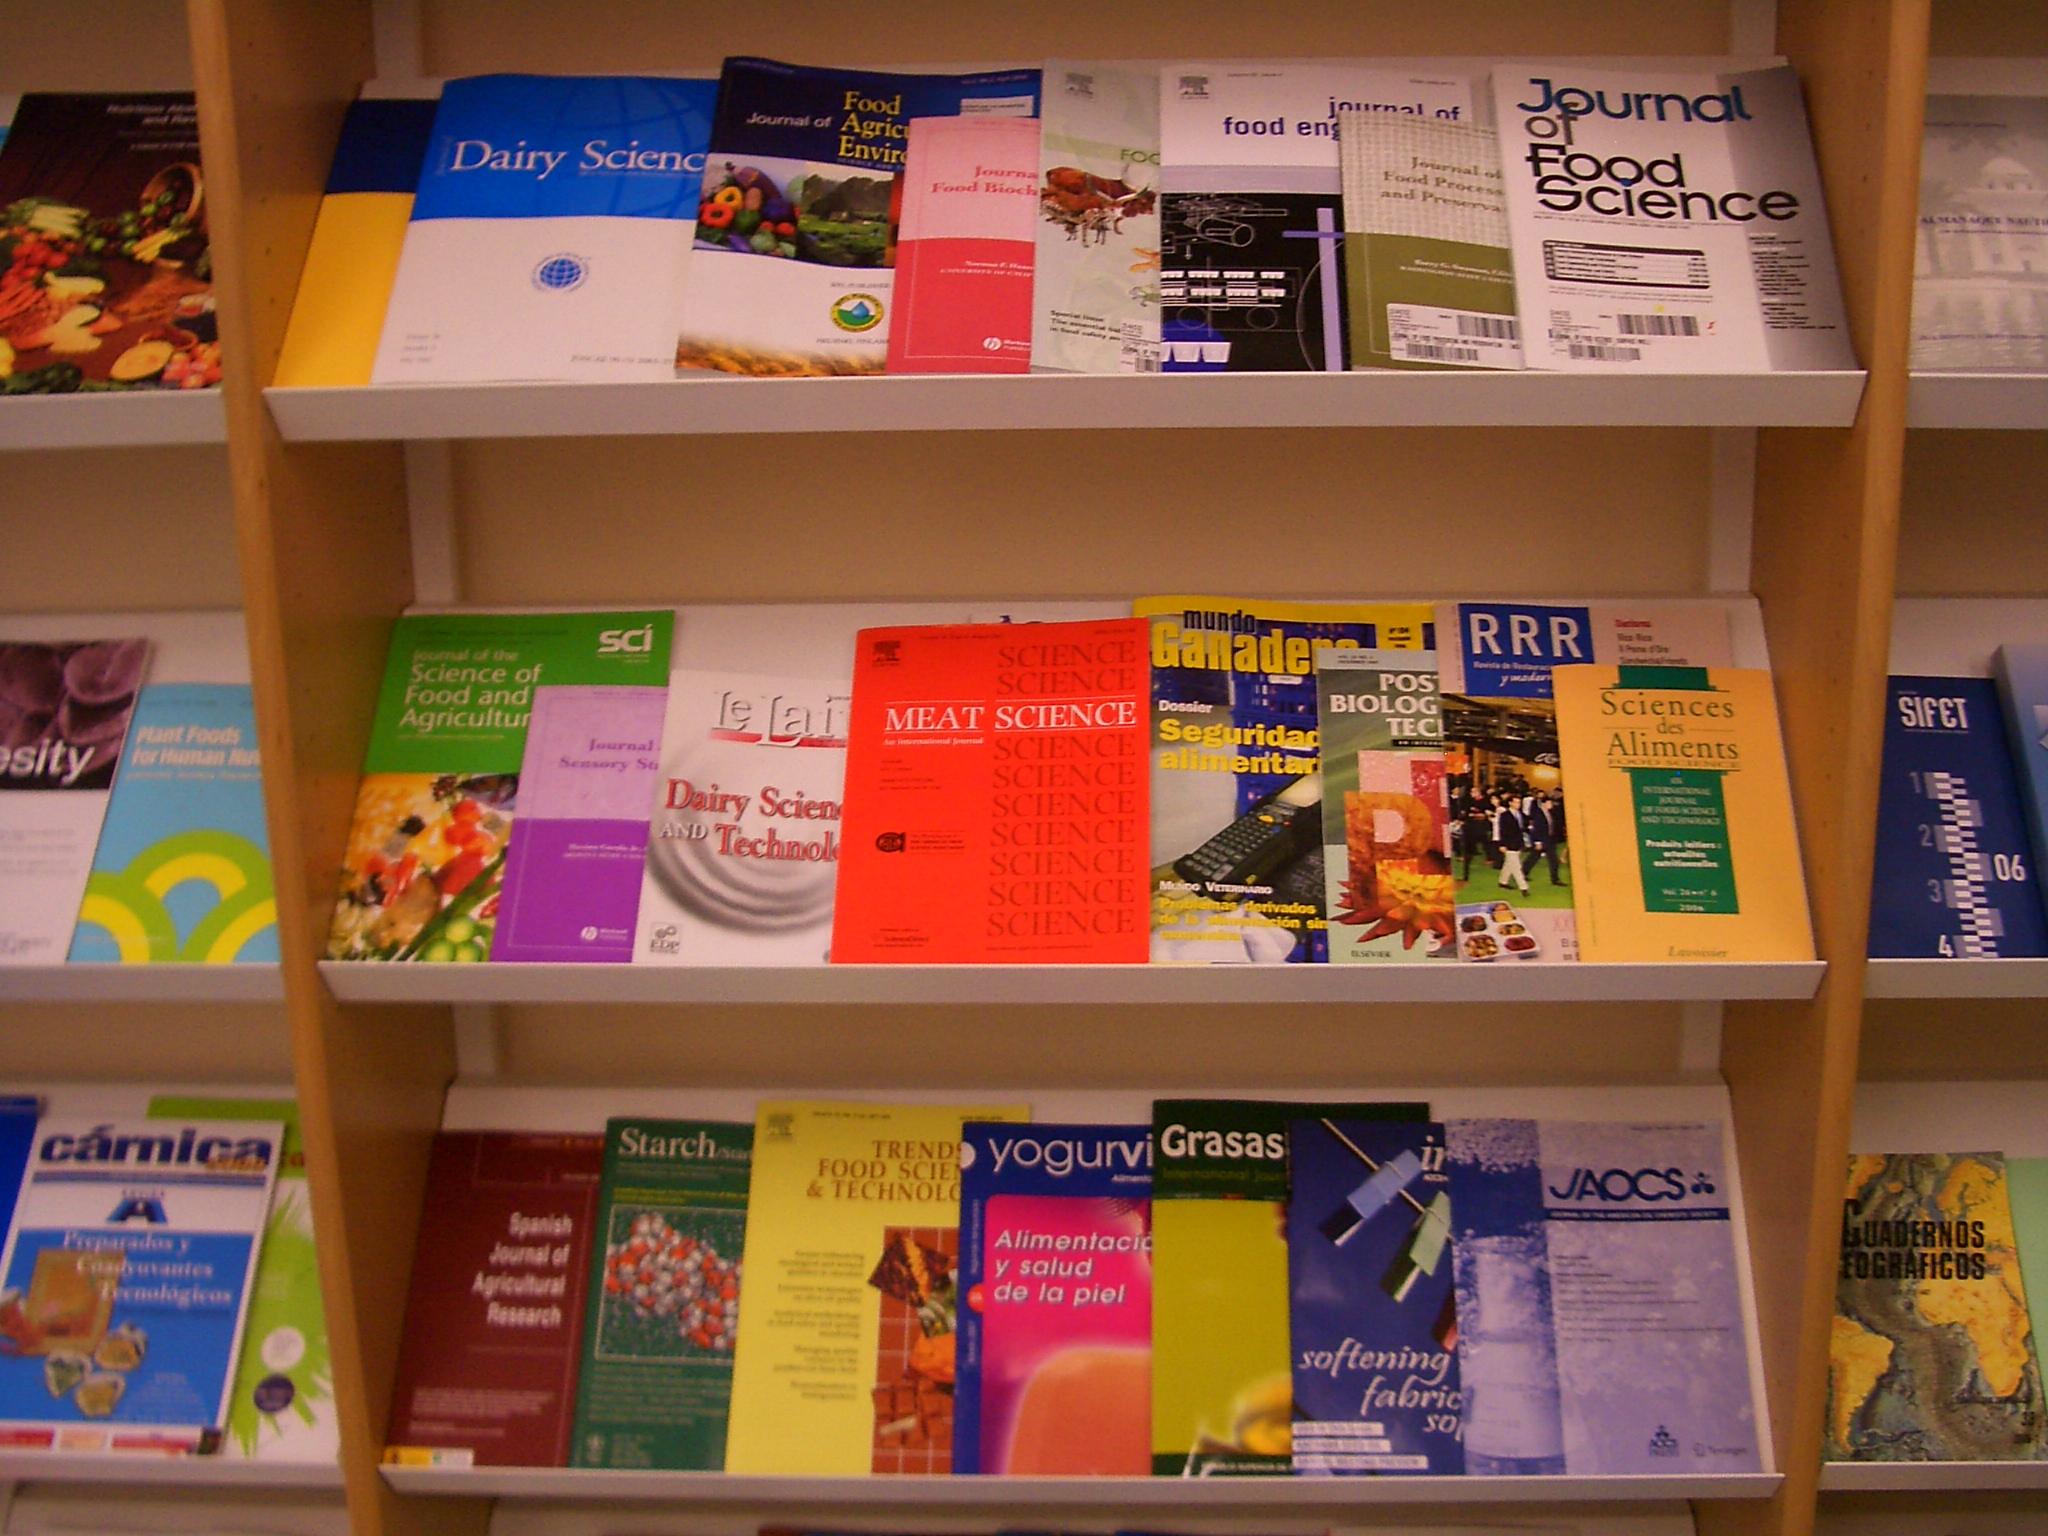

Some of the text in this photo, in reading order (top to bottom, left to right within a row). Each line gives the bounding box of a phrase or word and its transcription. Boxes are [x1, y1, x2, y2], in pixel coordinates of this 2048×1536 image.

[843, 91, 901, 115] Food
[1517, 78, 1753, 124] Journal
[746, 112, 834, 129] Journal of
[1223, 116, 1285, 136] food
[1524, 102, 1579, 146] of
[450, 140, 567, 180] Dairy
[579, 140, 705, 173] Scienc
[1411, 155, 1479, 177] Journal
[1525, 143, 1686, 188] Food
[931, 182, 979, 194] Food
[1383, 170, 1429, 186] Food
[1380, 189, 1416, 200] and
[1534, 175, 1800, 222] Science
[1183, 609, 1256, 634] mundo
[472, 649, 488, 662] of
[491, 649, 519, 662] the
[998, 641, 1137, 669] SCIENCE
[1152, 622, 1360, 676] Ganade
[410, 663, 543, 684] Science of
[997, 668, 1136, 696] SCIENCE
[403, 685, 529, 706] Food and
[1159, 700, 1214, 715] Dossier
[1329, 694, 1438, 715] BIOLOG
[1601, 691, 1736, 718] Sciences
[884, 701, 1137, 732] MEAT SCIENCE
[1898, 696, 1970, 730] SIFET
[1657, 717, 1684, 736] des
[588, 739, 653, 752] Journal
[994, 734, 1135, 760] SCIENCE
[1607, 731, 1740, 760] Aliments
[559, 757, 629, 773] Sensory
[993, 762, 1135, 789] SCIENCE
[1159, 750, 1320, 775] alimentar
[665, 777, 752, 821] Dairy
[992, 791, 1135, 818] SCIENCE
[658, 822, 709, 840] AND
[991, 819, 1135, 847] SCIENCE
[1918, 824, 1933, 848] 2
[990, 849, 1135, 876] SCIENCE
[1994, 853, 2027, 882] 06
[989, 879, 1135, 907] SCIENCE
[1929, 880, 1943, 903] 3
[1245, 900, 1317, 915] derivados
[987, 909, 1135, 937] SCIENCE
[1937, 935, 1955, 958] 4
[38, 1124, 273, 1167] cárnica
[617, 1127, 717, 1160] Starch
[1160, 1123, 1285, 1160] Grasas
[818, 1158, 887, 1180] FOOD
[805, 1180, 823, 1198] &
[1549, 1167, 1687, 1202] JAOCS
[509, 1211, 573, 1239] Spanish
[63, 1231, 192, 1256] Preparados y
[488, 1243, 571, 1267] Journal of
[993, 1257, 1093, 1279] y salud
[471, 1272, 567, 1299] Agricultural
[994, 1281, 1126, 1307] de la piel
[486, 1301, 562, 1329] Research
[1298, 1337, 1451, 1386] softening
